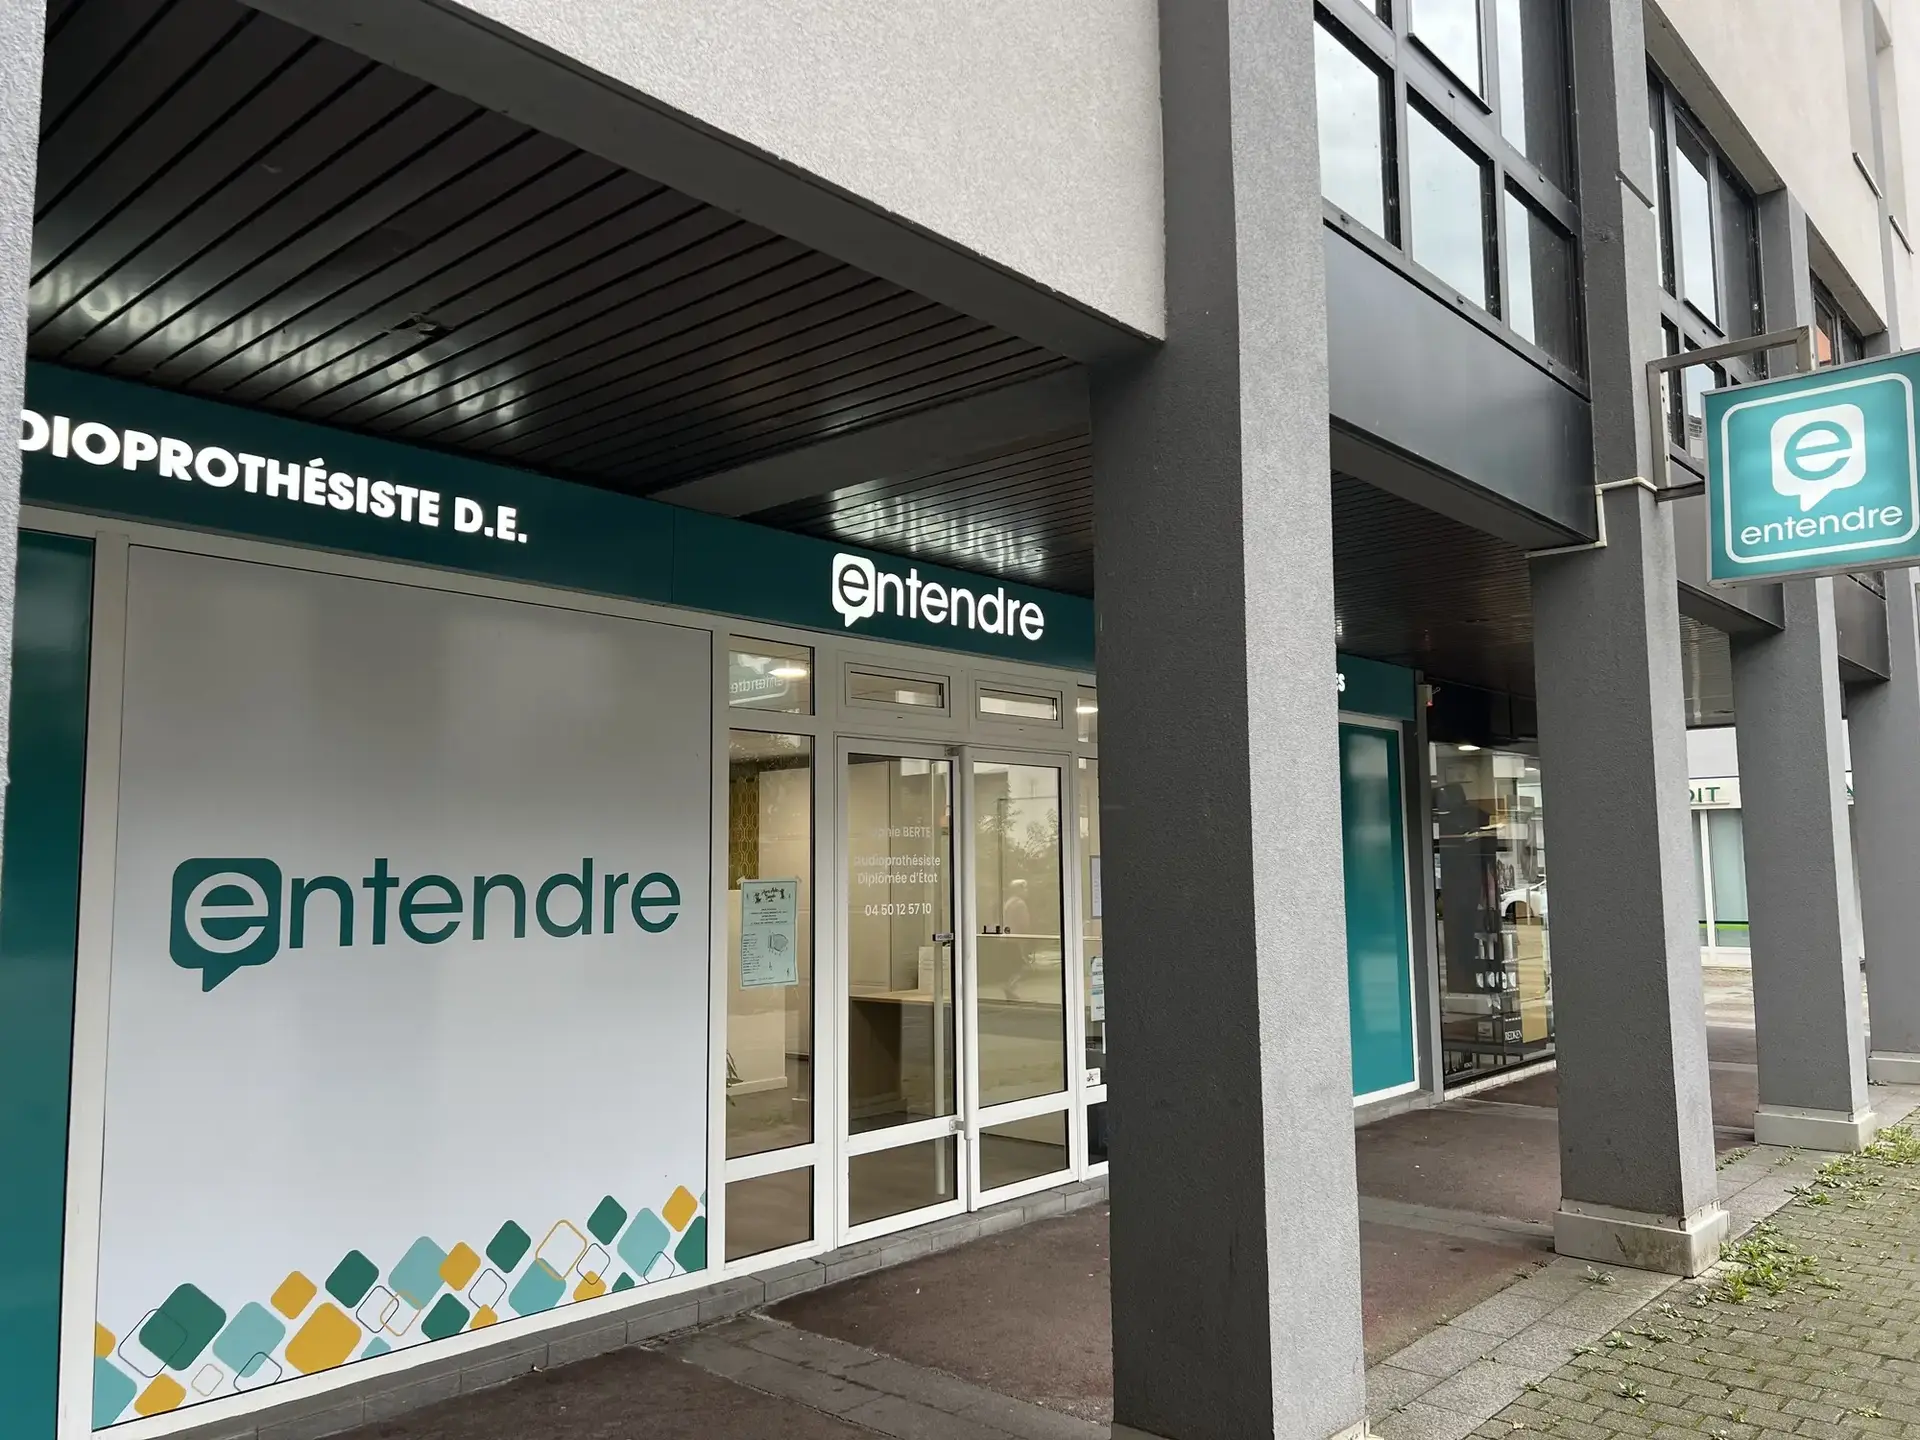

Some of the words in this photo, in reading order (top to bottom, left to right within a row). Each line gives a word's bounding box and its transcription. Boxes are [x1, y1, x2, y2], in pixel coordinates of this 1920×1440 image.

[454, 496, 528, 543] D.E.
[1741, 505, 1904, 545] entendre
[836, 560, 1045, 641] entendre
[854, 853, 941, 869] Audioprothésiste
[857, 871, 907, 887] Diplômée
[909, 868, 938, 884] d'État
[183, 857, 681, 955] entendre
[865, 904, 879, 916] 04
[881, 904, 894, 916] 50
[896, 903, 906, 915] 12
[908, 903, 920, 915] 57
[921, 902, 932, 914] 10
